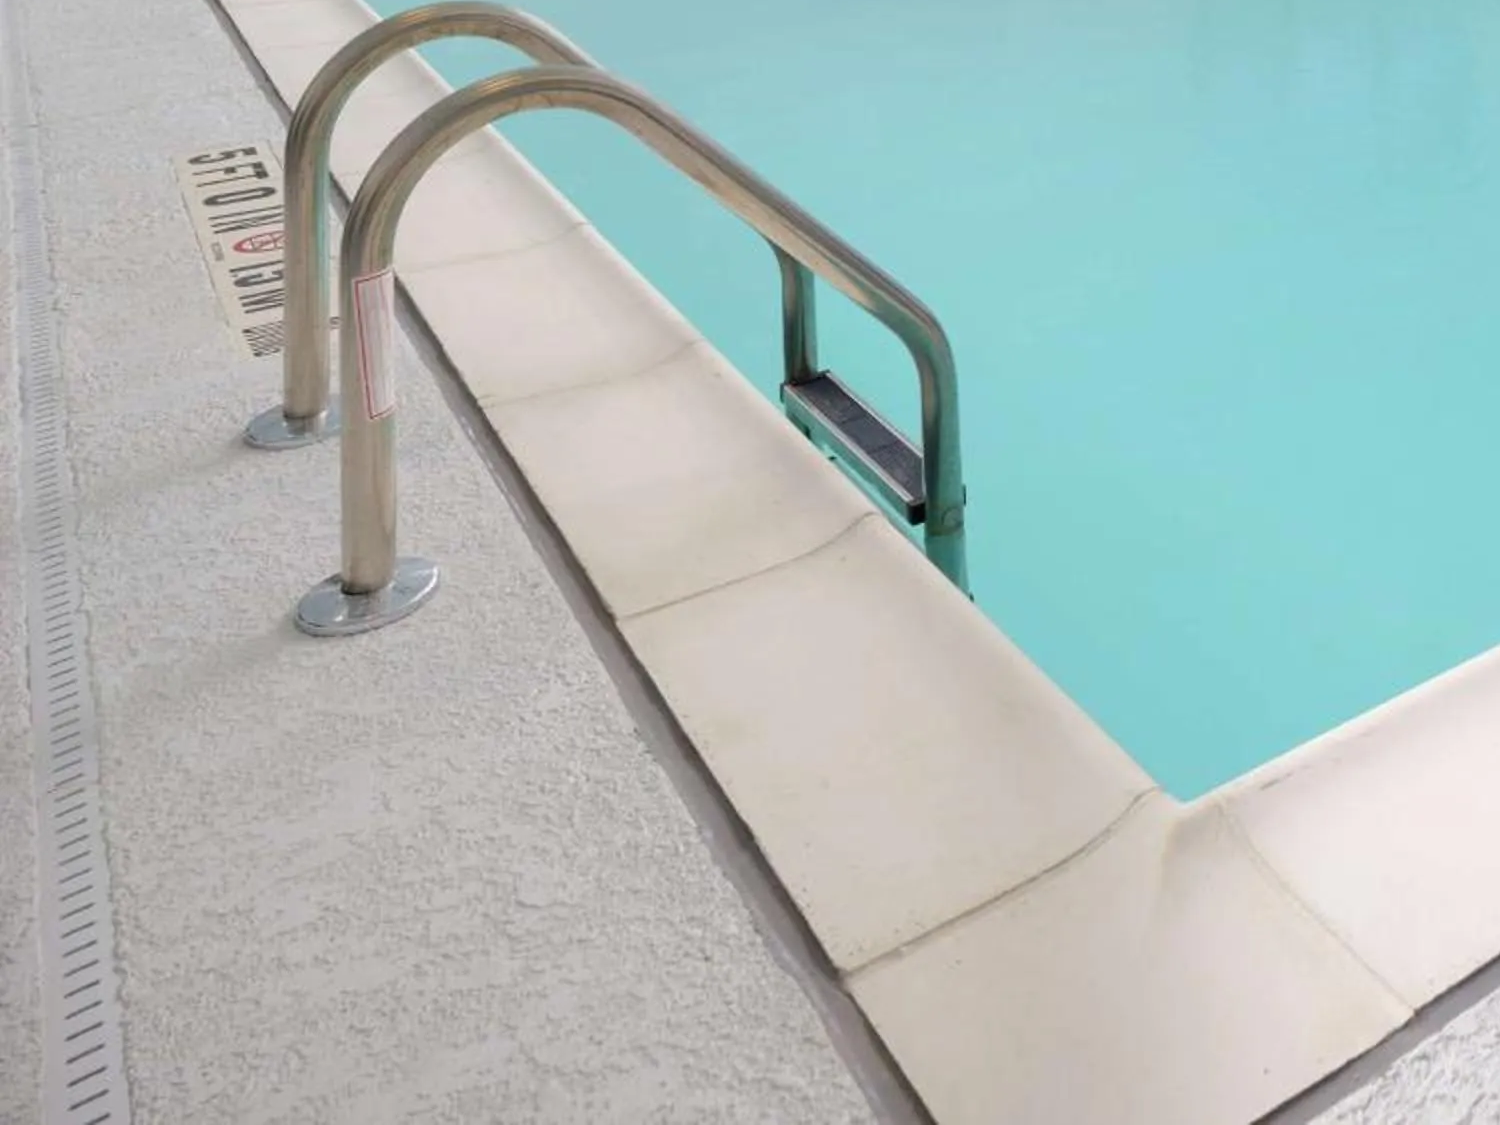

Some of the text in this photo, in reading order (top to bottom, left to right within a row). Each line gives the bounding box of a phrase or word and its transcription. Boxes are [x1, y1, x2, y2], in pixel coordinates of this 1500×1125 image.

[187, 146, 258, 166] 5
[192, 160, 269, 188] FT
[208, 205, 285, 234] IN
